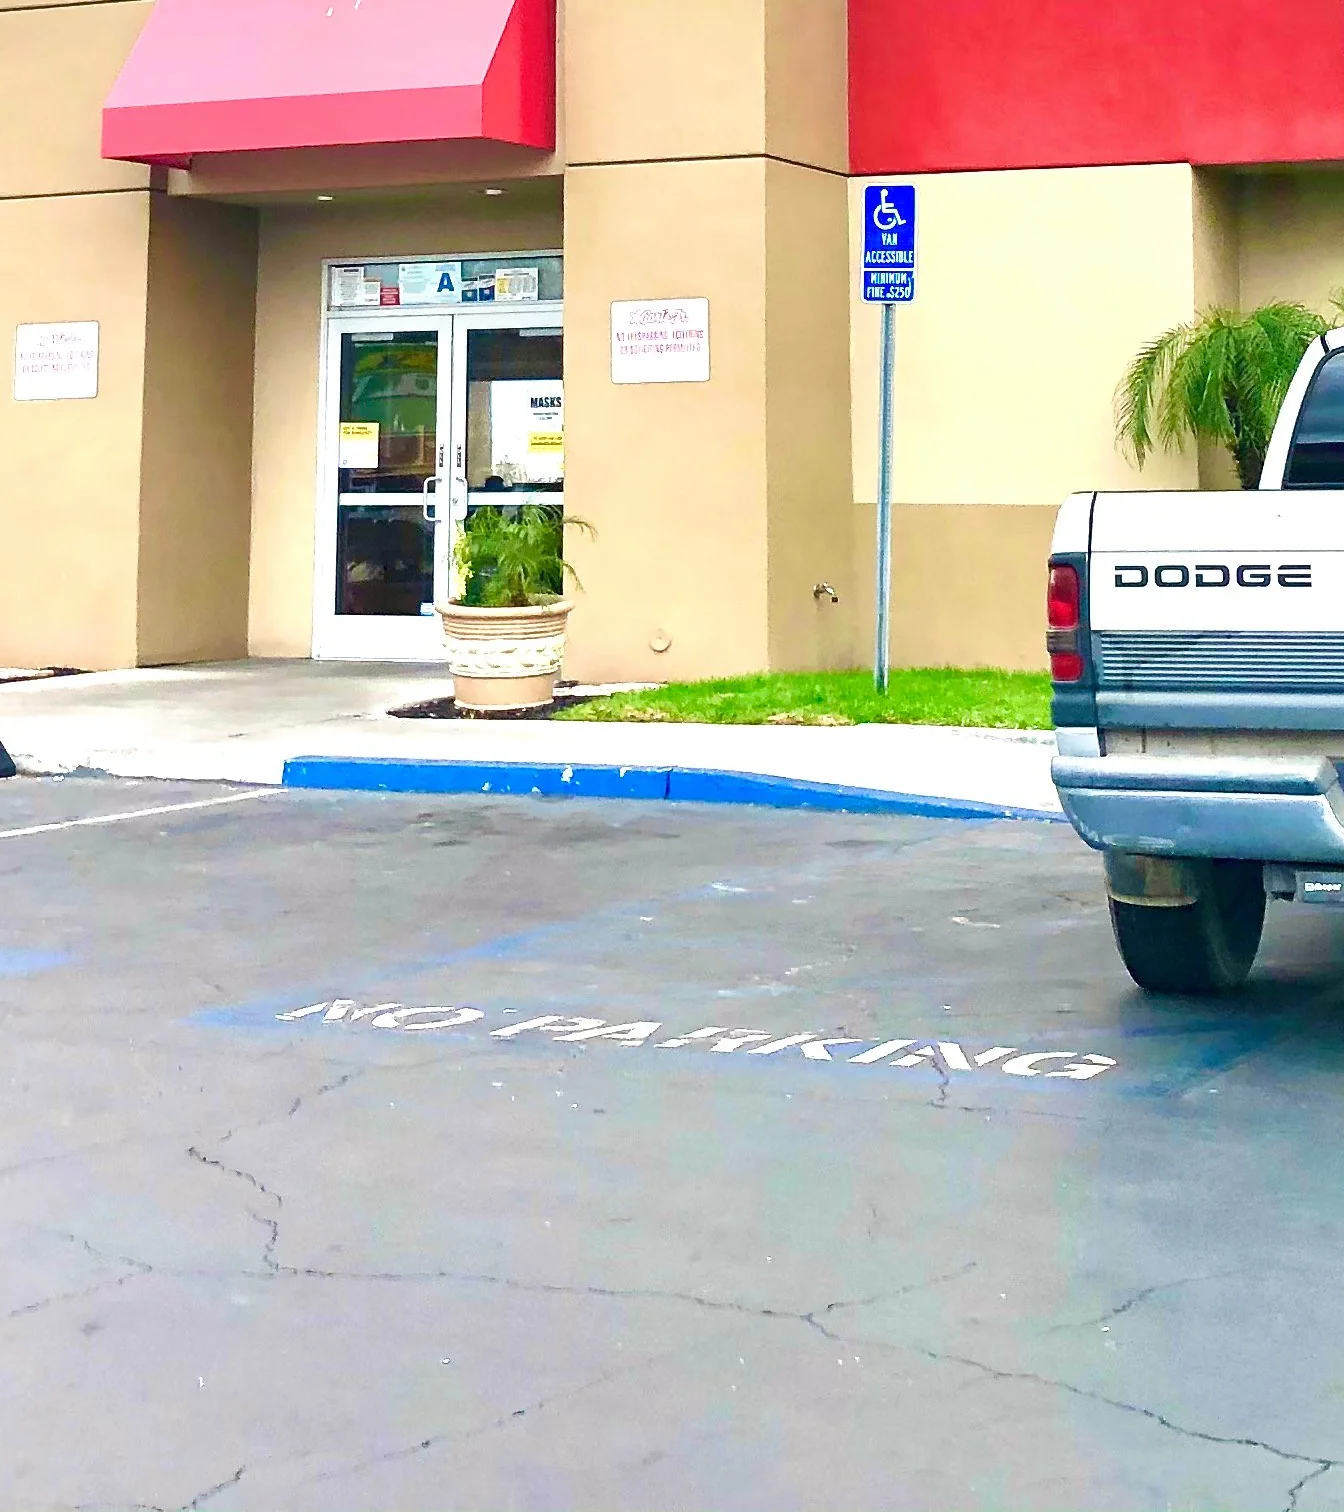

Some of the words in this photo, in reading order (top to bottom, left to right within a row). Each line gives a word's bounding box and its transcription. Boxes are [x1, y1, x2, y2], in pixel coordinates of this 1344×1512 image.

[881, 232, 898, 246] VAN
[865, 250, 914, 263] ACCESSIBLE
[437, 272, 455, 292] A
[870, 272, 907, 284] MINIMUM
[866, 286, 885, 299] FINE
[889, 286, 911, 299] $250
[530, 396, 562, 408] MASKS
[1114, 564, 1312, 588] DODGE
[275, 998, 484, 1032] NO
[490, 1014, 1118, 1081] PARKING
